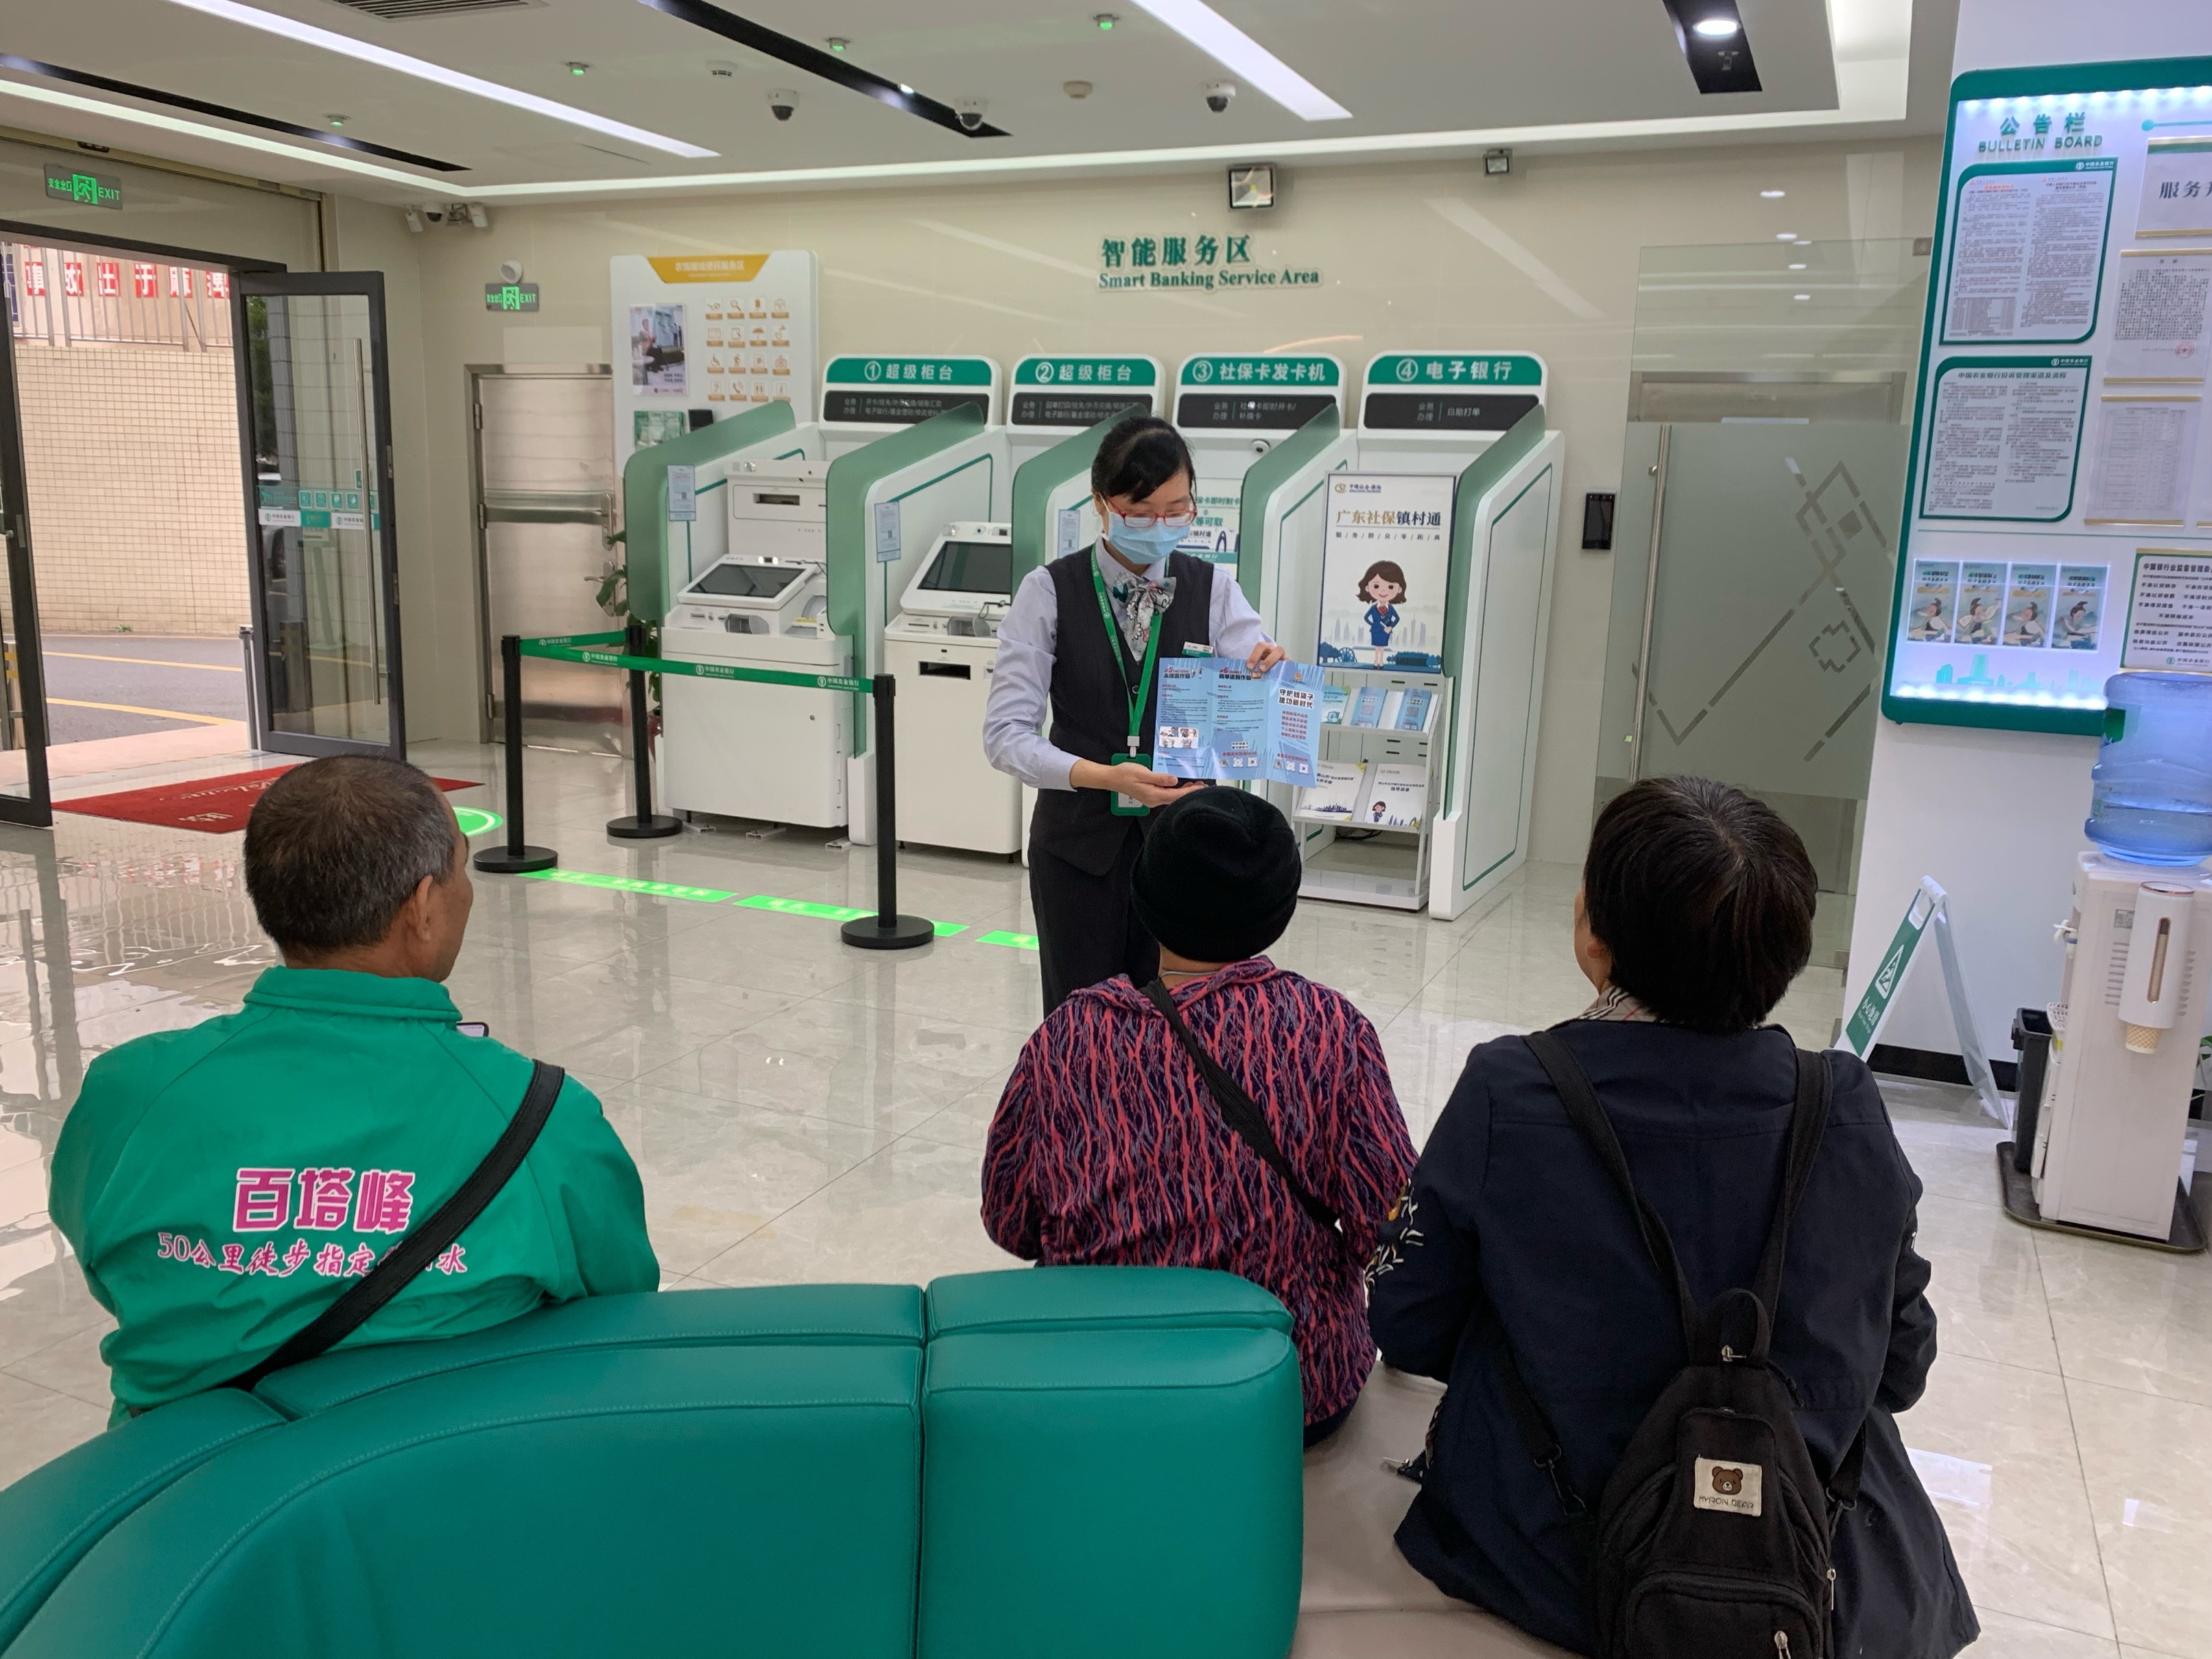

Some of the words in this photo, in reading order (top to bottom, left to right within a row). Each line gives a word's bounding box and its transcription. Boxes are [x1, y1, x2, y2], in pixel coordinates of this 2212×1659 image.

[1999, 112, 2085, 135] 公告栏
[1978, 138, 2045, 152] BULLETIN
[2054, 135, 2103, 149] BOARD
[48, 178, 72, 192] 安全出口
[97, 187, 120, 200] EXIT
[1101, 234, 1250, 268] 智能服务区
[1099, 273, 1145, 289] Smart
[1150, 272, 1214, 289] Banking
[1219, 270, 1276, 285] Service
[1280, 268, 1320, 285] Area
[520, 293, 536, 302] EXIT
[1336, 509, 1441, 526] 广东社保镇村通
[2143, 562, 2212, 573] 中国银行业监督管理委
[704, 665, 735, 675] 中国农业银行
[827, 678, 859, 686] 中国农业银行
[1279, 689, 1313, 700] 守护钱袋子
[1279, 696, 1313, 708] 建功新时代
[232, 1167, 415, 1234] 百塔峰
[157, 1231, 468, 1278] 50公里徒步指定水
[1698, 1496, 1728, 1505] MYRON
[1731, 1499, 1754, 1509] BEAR
